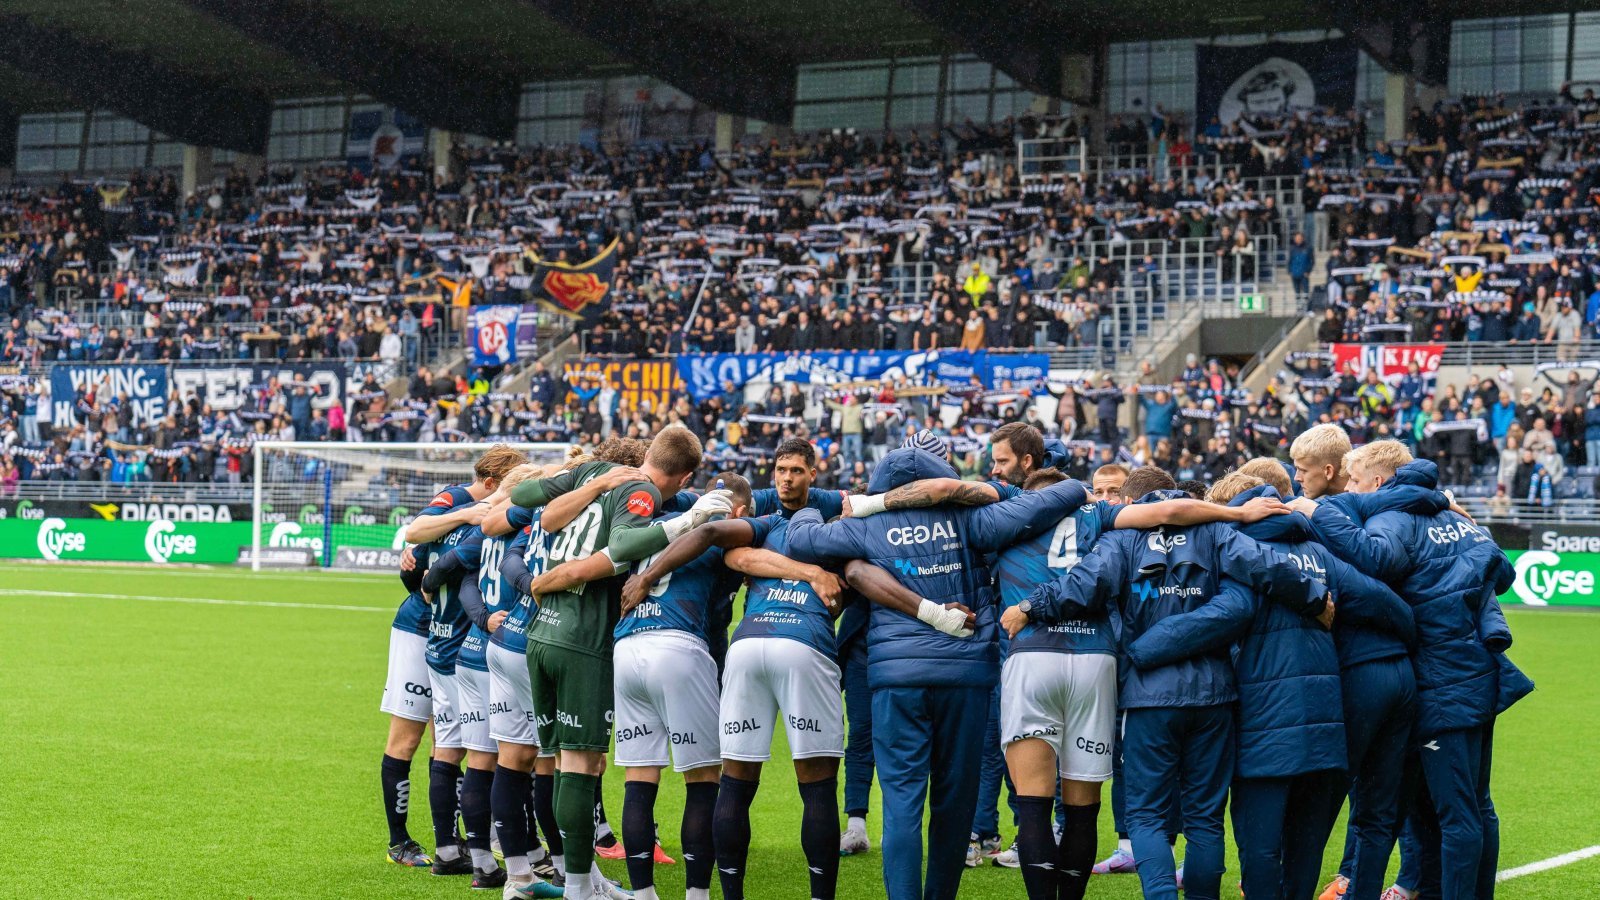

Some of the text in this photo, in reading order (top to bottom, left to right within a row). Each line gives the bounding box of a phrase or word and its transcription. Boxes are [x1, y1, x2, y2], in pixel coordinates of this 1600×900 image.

[121, 503, 232, 523] DIADORA
[48, 530, 86, 555] Lyse
[156, 532, 197, 558] Lyse
[1047, 516, 1082, 574] 4
[356, 551, 378, 566] K2
[918, 562, 961, 576] NorEngros
[1529, 566, 1595, 600] Lyse
[1047, 626, 1096, 635] KJÆRLIGHET
